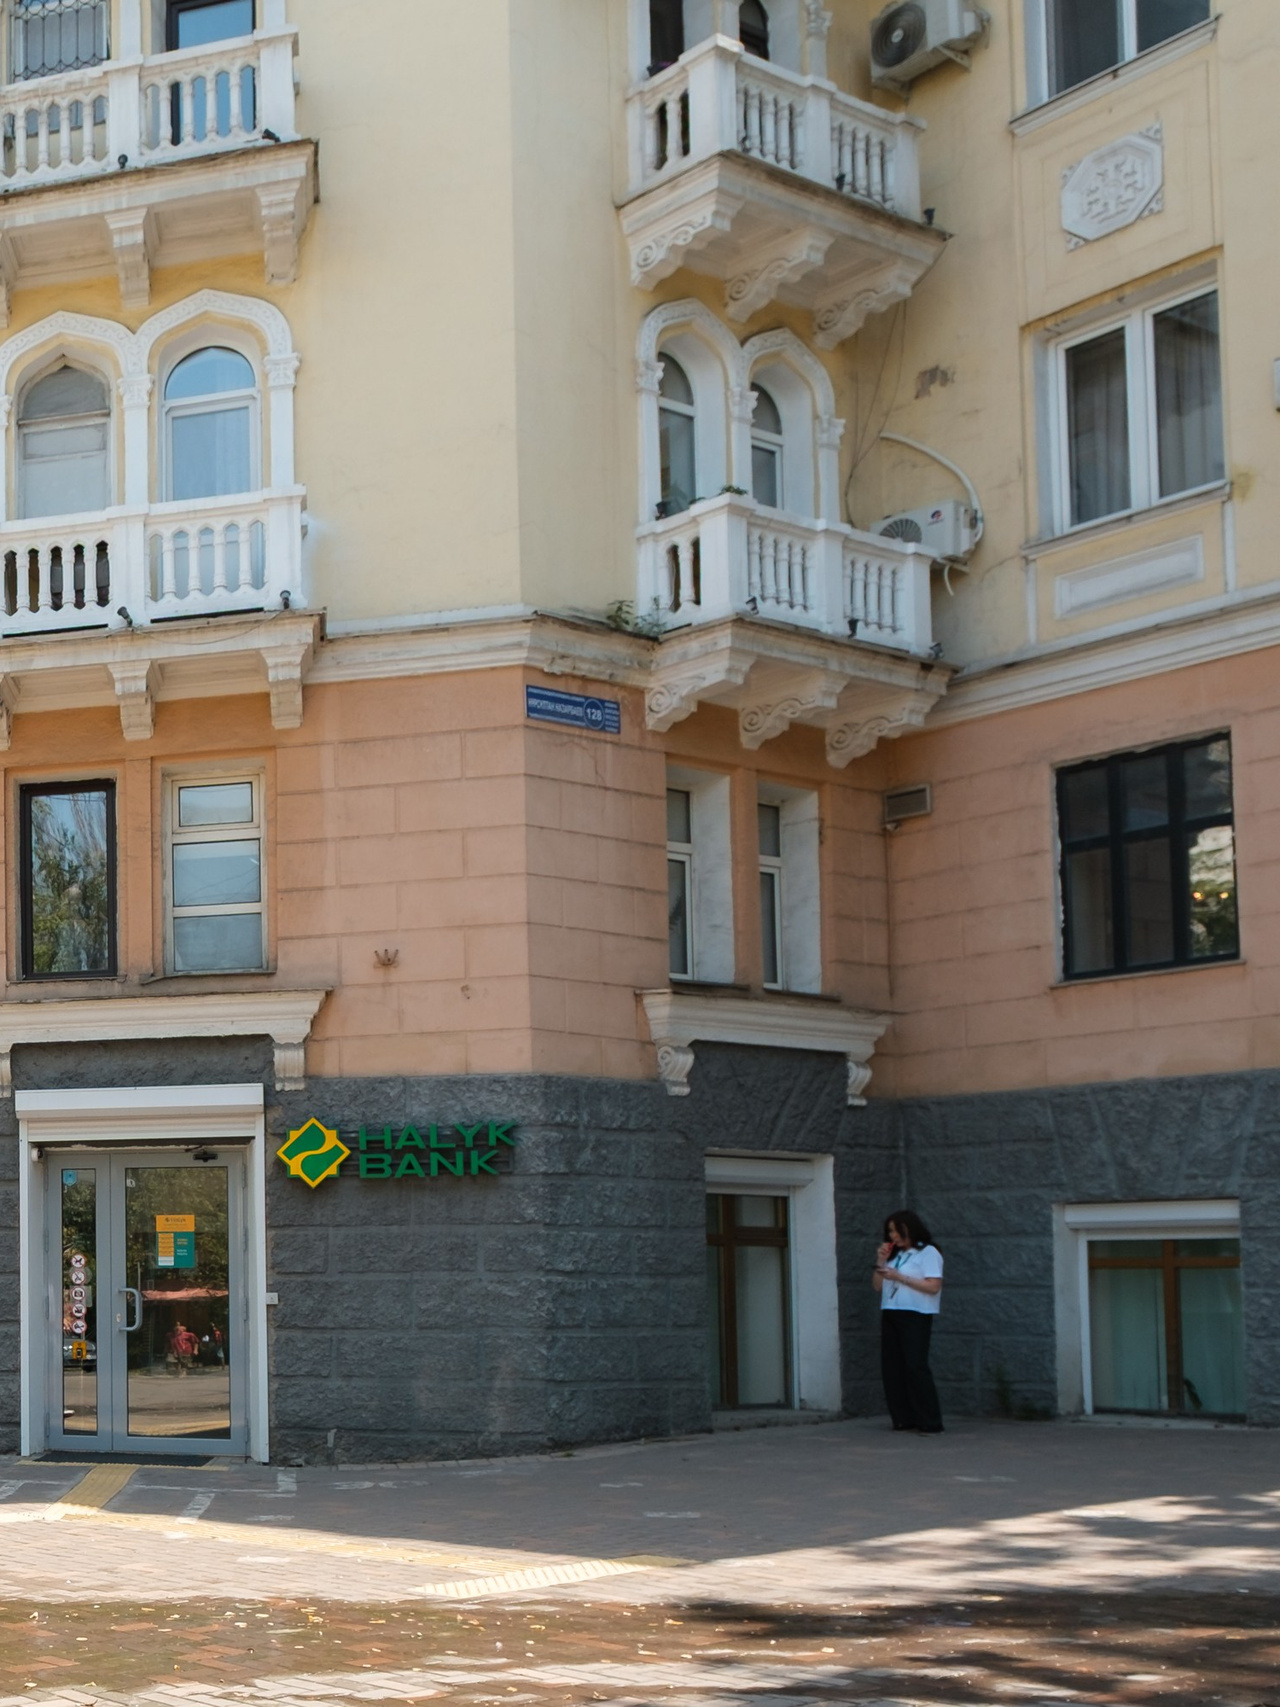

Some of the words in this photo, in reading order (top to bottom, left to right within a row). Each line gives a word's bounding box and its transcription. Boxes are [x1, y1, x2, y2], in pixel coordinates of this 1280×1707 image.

[586, 708, 602, 721] 128
[359, 1120, 516, 1150] HALYK
[359, 1150, 499, 1179] BANK
